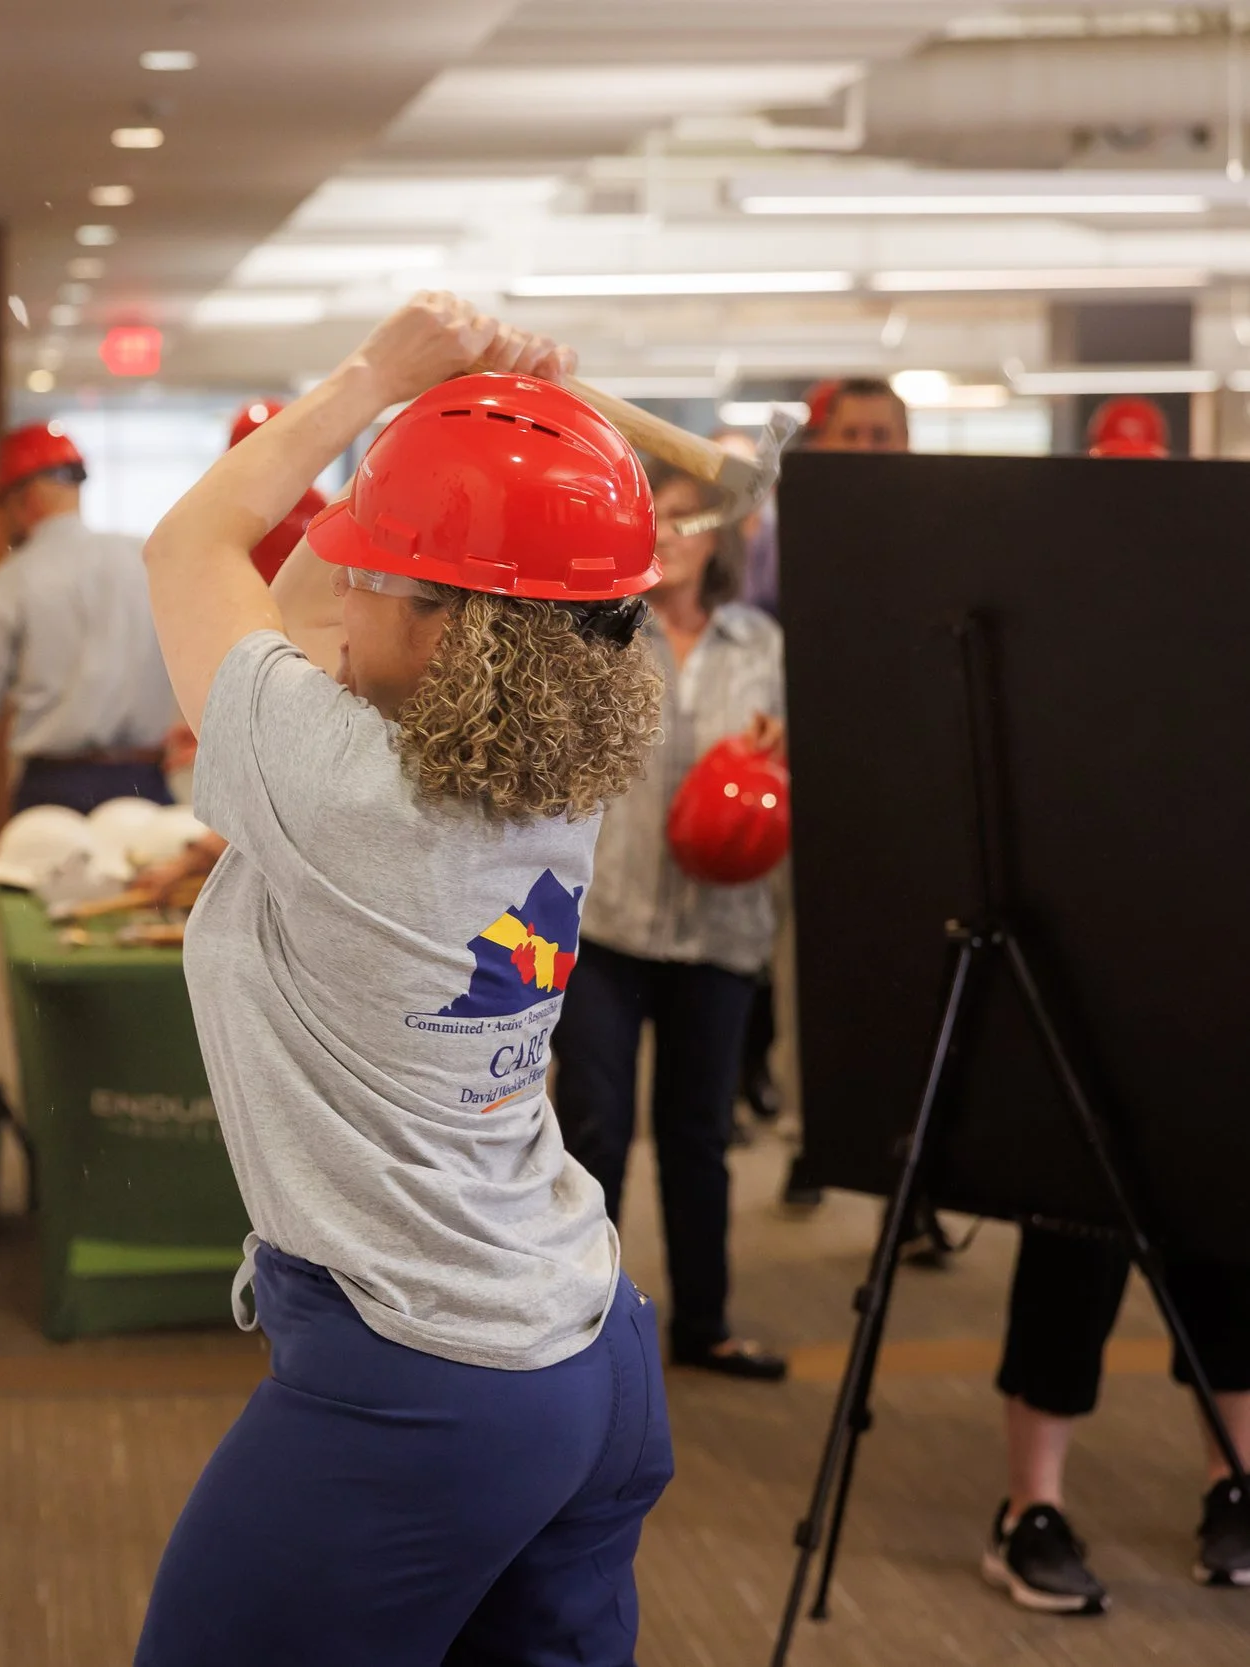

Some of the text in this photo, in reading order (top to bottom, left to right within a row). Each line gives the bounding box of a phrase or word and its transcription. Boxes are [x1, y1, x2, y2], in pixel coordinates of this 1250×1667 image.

[405, 1015, 484, 1035] Committed
[494, 1019, 523, 1033] Active
[490, 1027, 548, 1079] CARE
[460, 1087, 498, 1104] David
[527, 1067, 547, 1086] Hom
